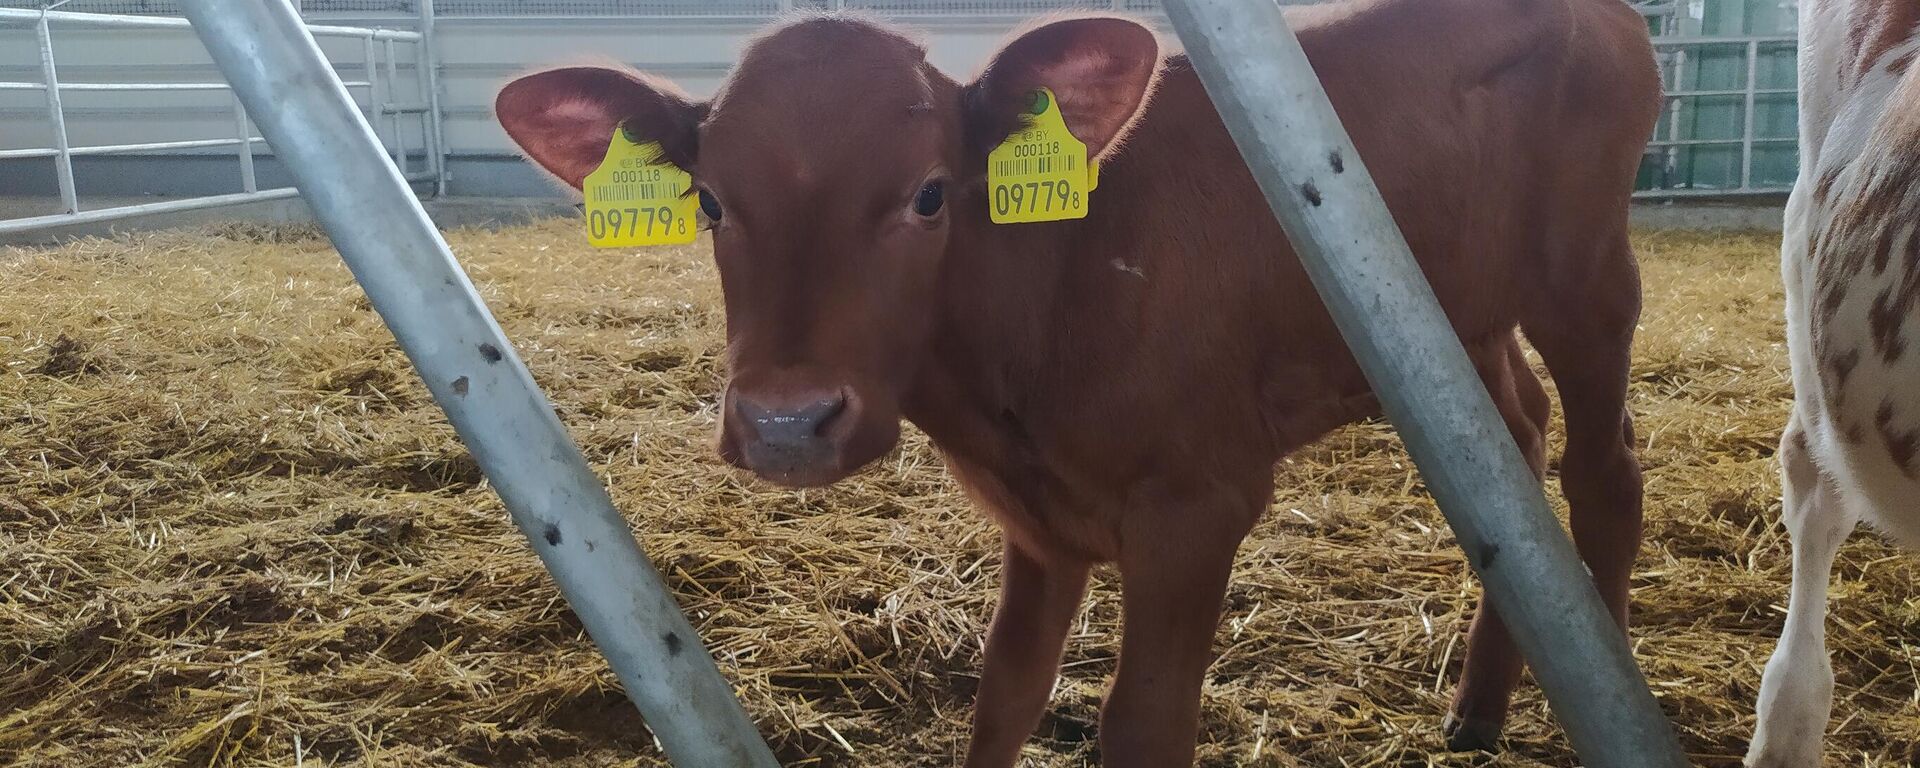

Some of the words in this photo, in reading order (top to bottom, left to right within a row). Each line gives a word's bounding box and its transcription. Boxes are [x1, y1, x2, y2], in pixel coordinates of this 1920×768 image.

[1036, 130, 1050, 141] BY
[1014, 141, 1060, 157] 000118
[612, 169, 661, 183] 000118
[590, 206, 673, 239] 09779
